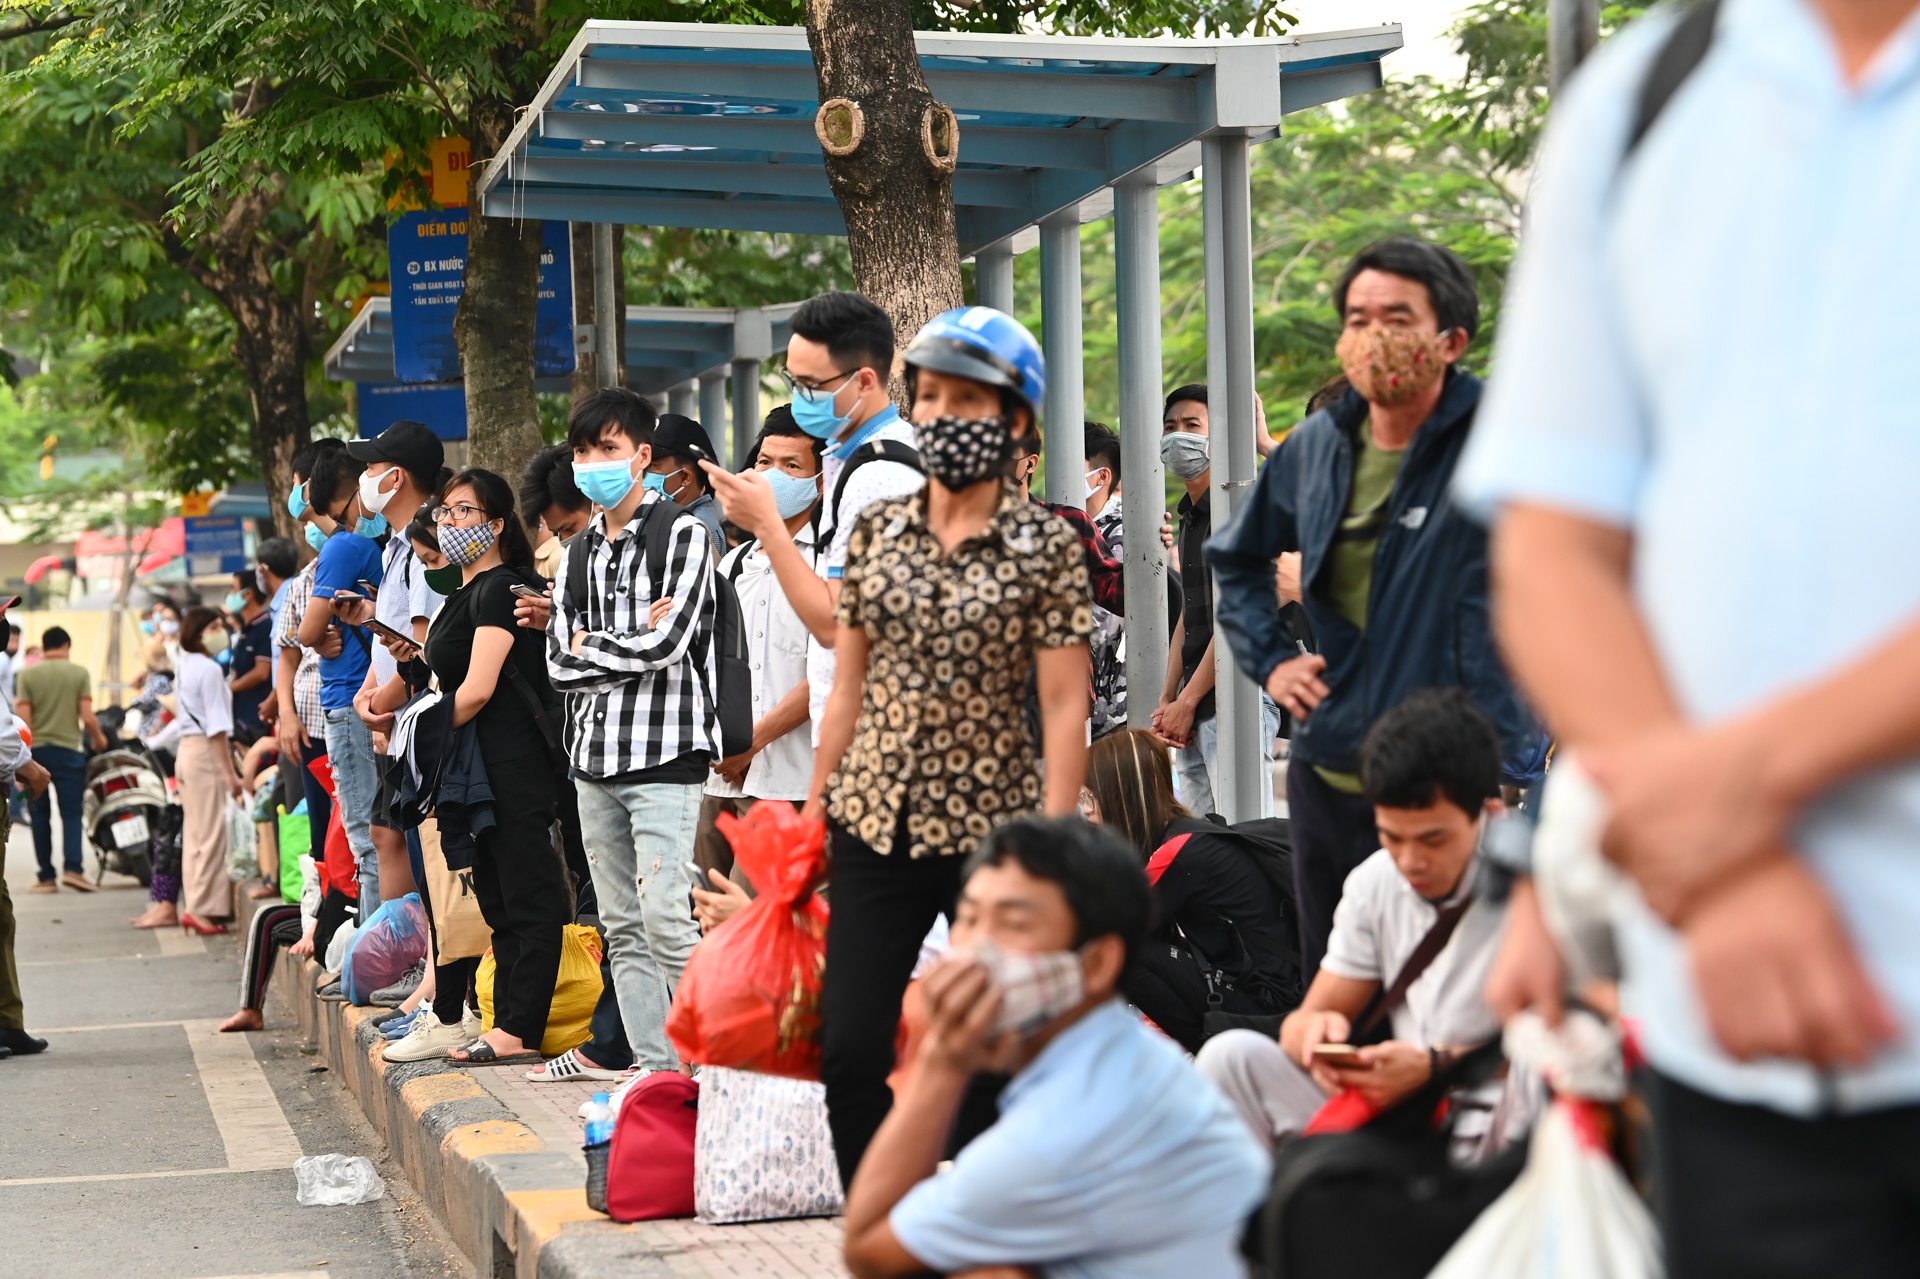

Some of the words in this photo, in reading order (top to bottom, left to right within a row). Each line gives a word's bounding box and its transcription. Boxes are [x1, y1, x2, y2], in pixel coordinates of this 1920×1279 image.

[448, 150, 471, 172] ĐI
[450, 219, 468, 235] ĐÓ
[424, 260, 437, 272] BX
[439, 256, 464, 271] NƯỚC
[428, 281, 443, 290] GIAN
[444, 280, 460, 289] HOẠT
